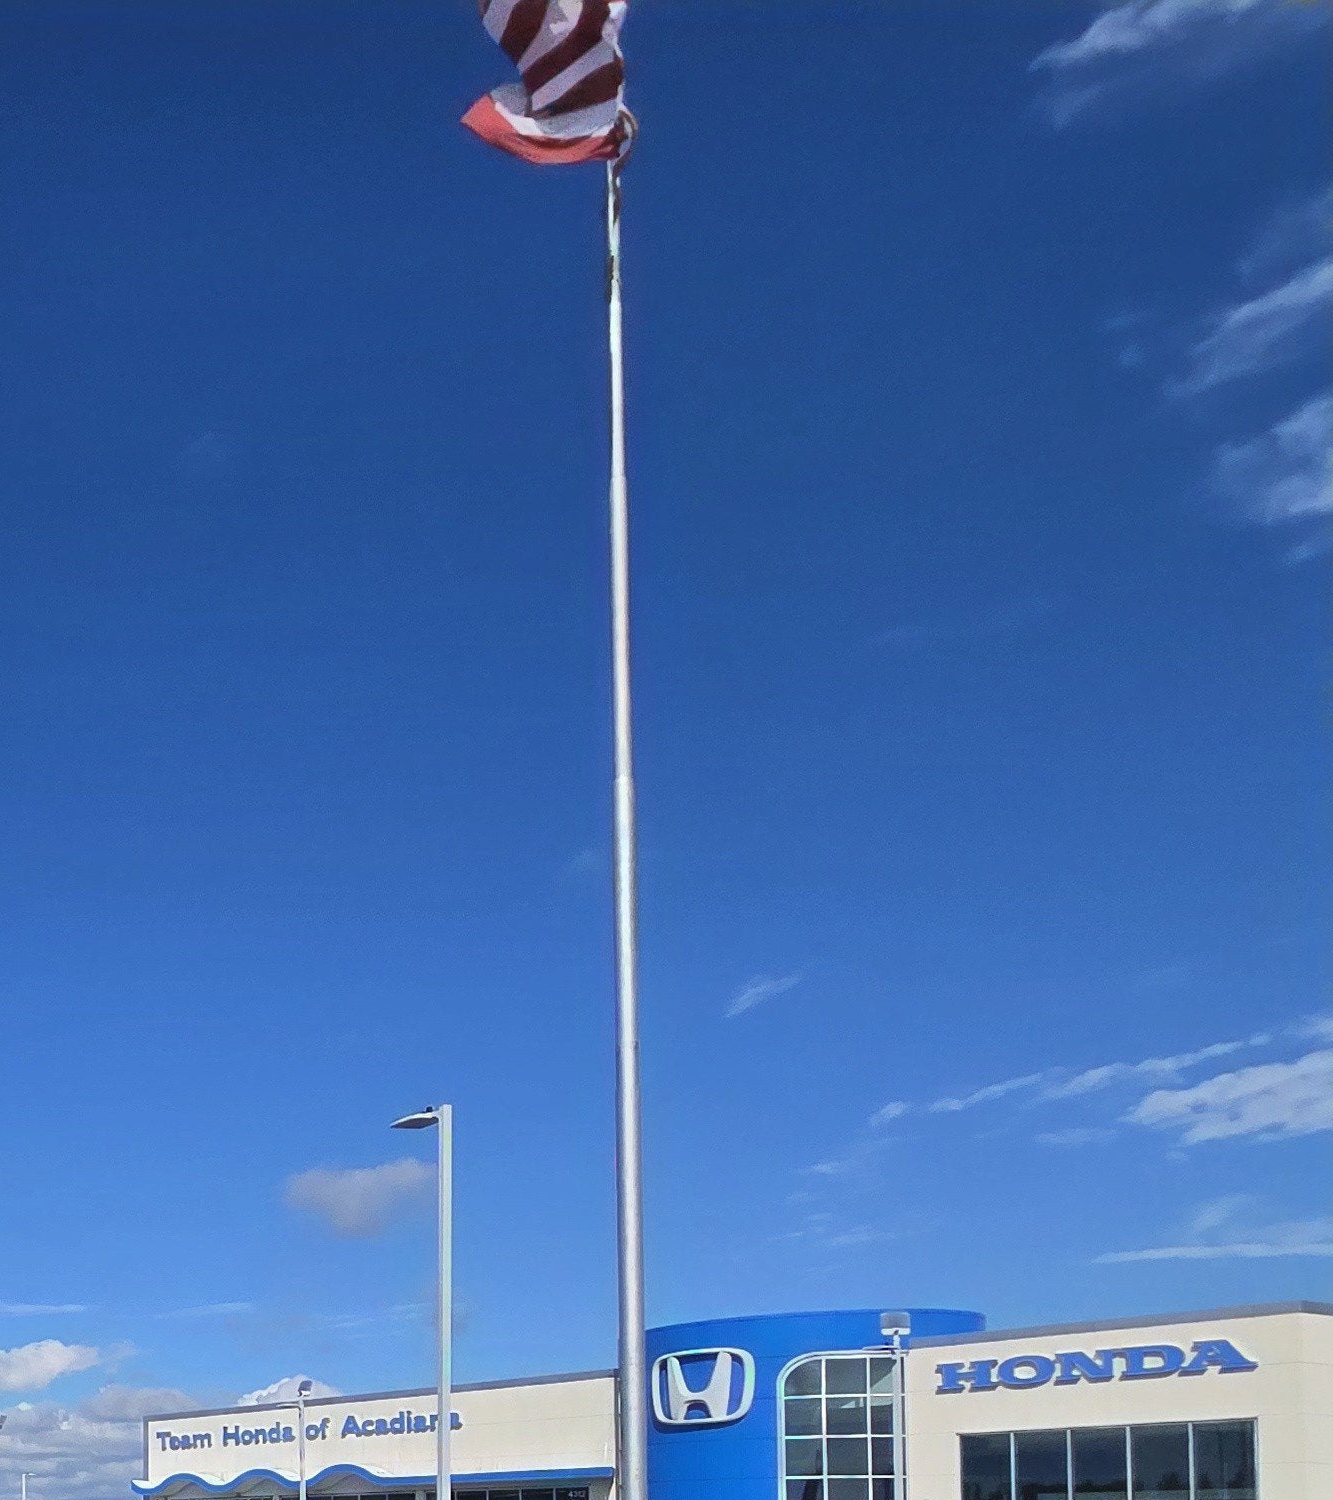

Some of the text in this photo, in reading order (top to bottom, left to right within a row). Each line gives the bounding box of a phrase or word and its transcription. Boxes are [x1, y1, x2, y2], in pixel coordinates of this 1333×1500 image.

[935, 1339, 1259, 1395] HONDA
[156, 1431, 212, 1451] Team
[222, 1422, 296, 1447] Honda
[305, 1417, 331, 1441] of
